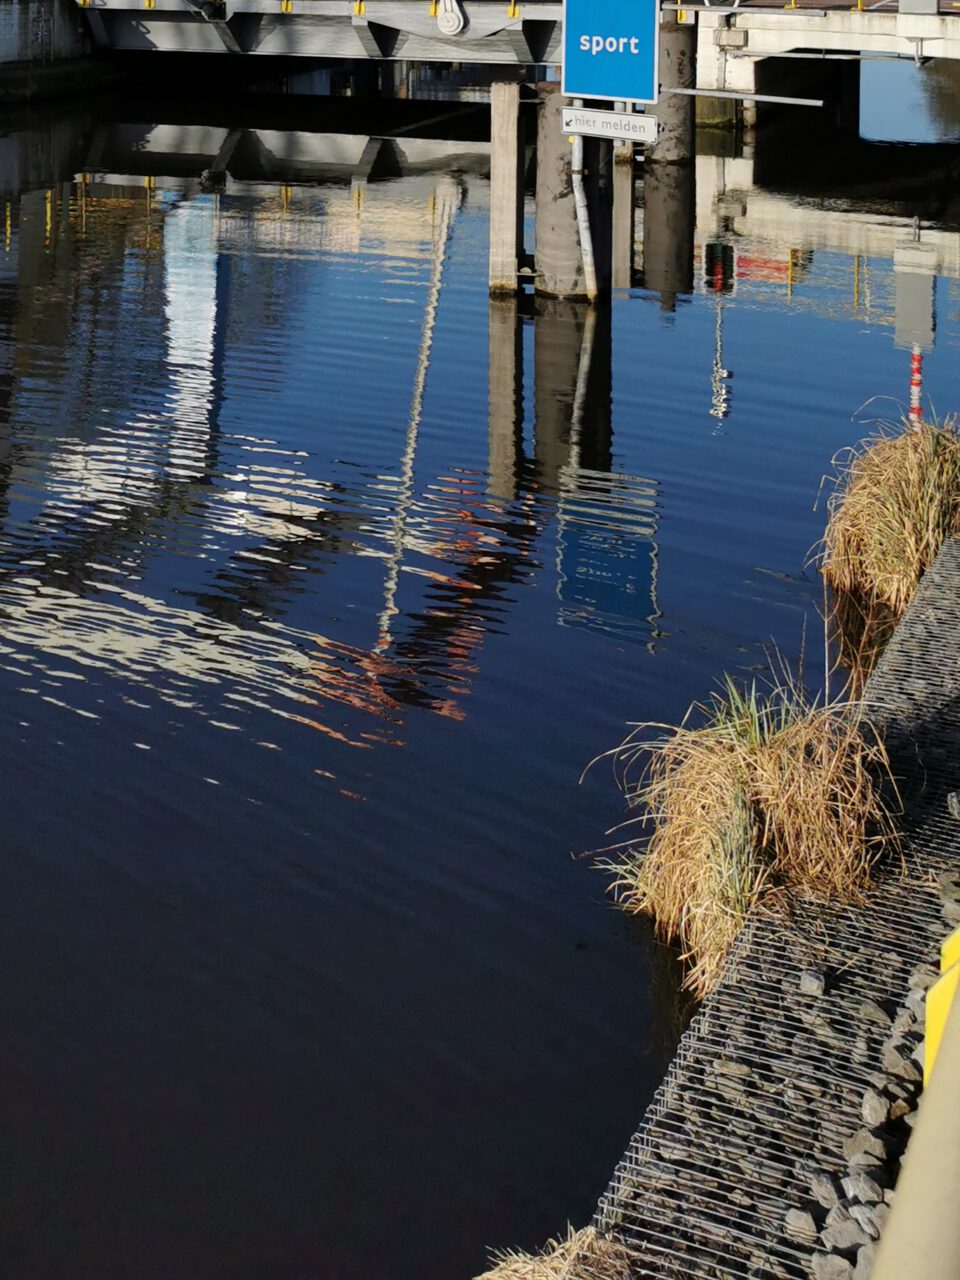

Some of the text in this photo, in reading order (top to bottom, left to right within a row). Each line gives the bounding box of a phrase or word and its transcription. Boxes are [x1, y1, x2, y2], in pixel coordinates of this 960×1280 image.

[579, 34, 640, 56] sport
[574, 114, 646, 134] hier melden
